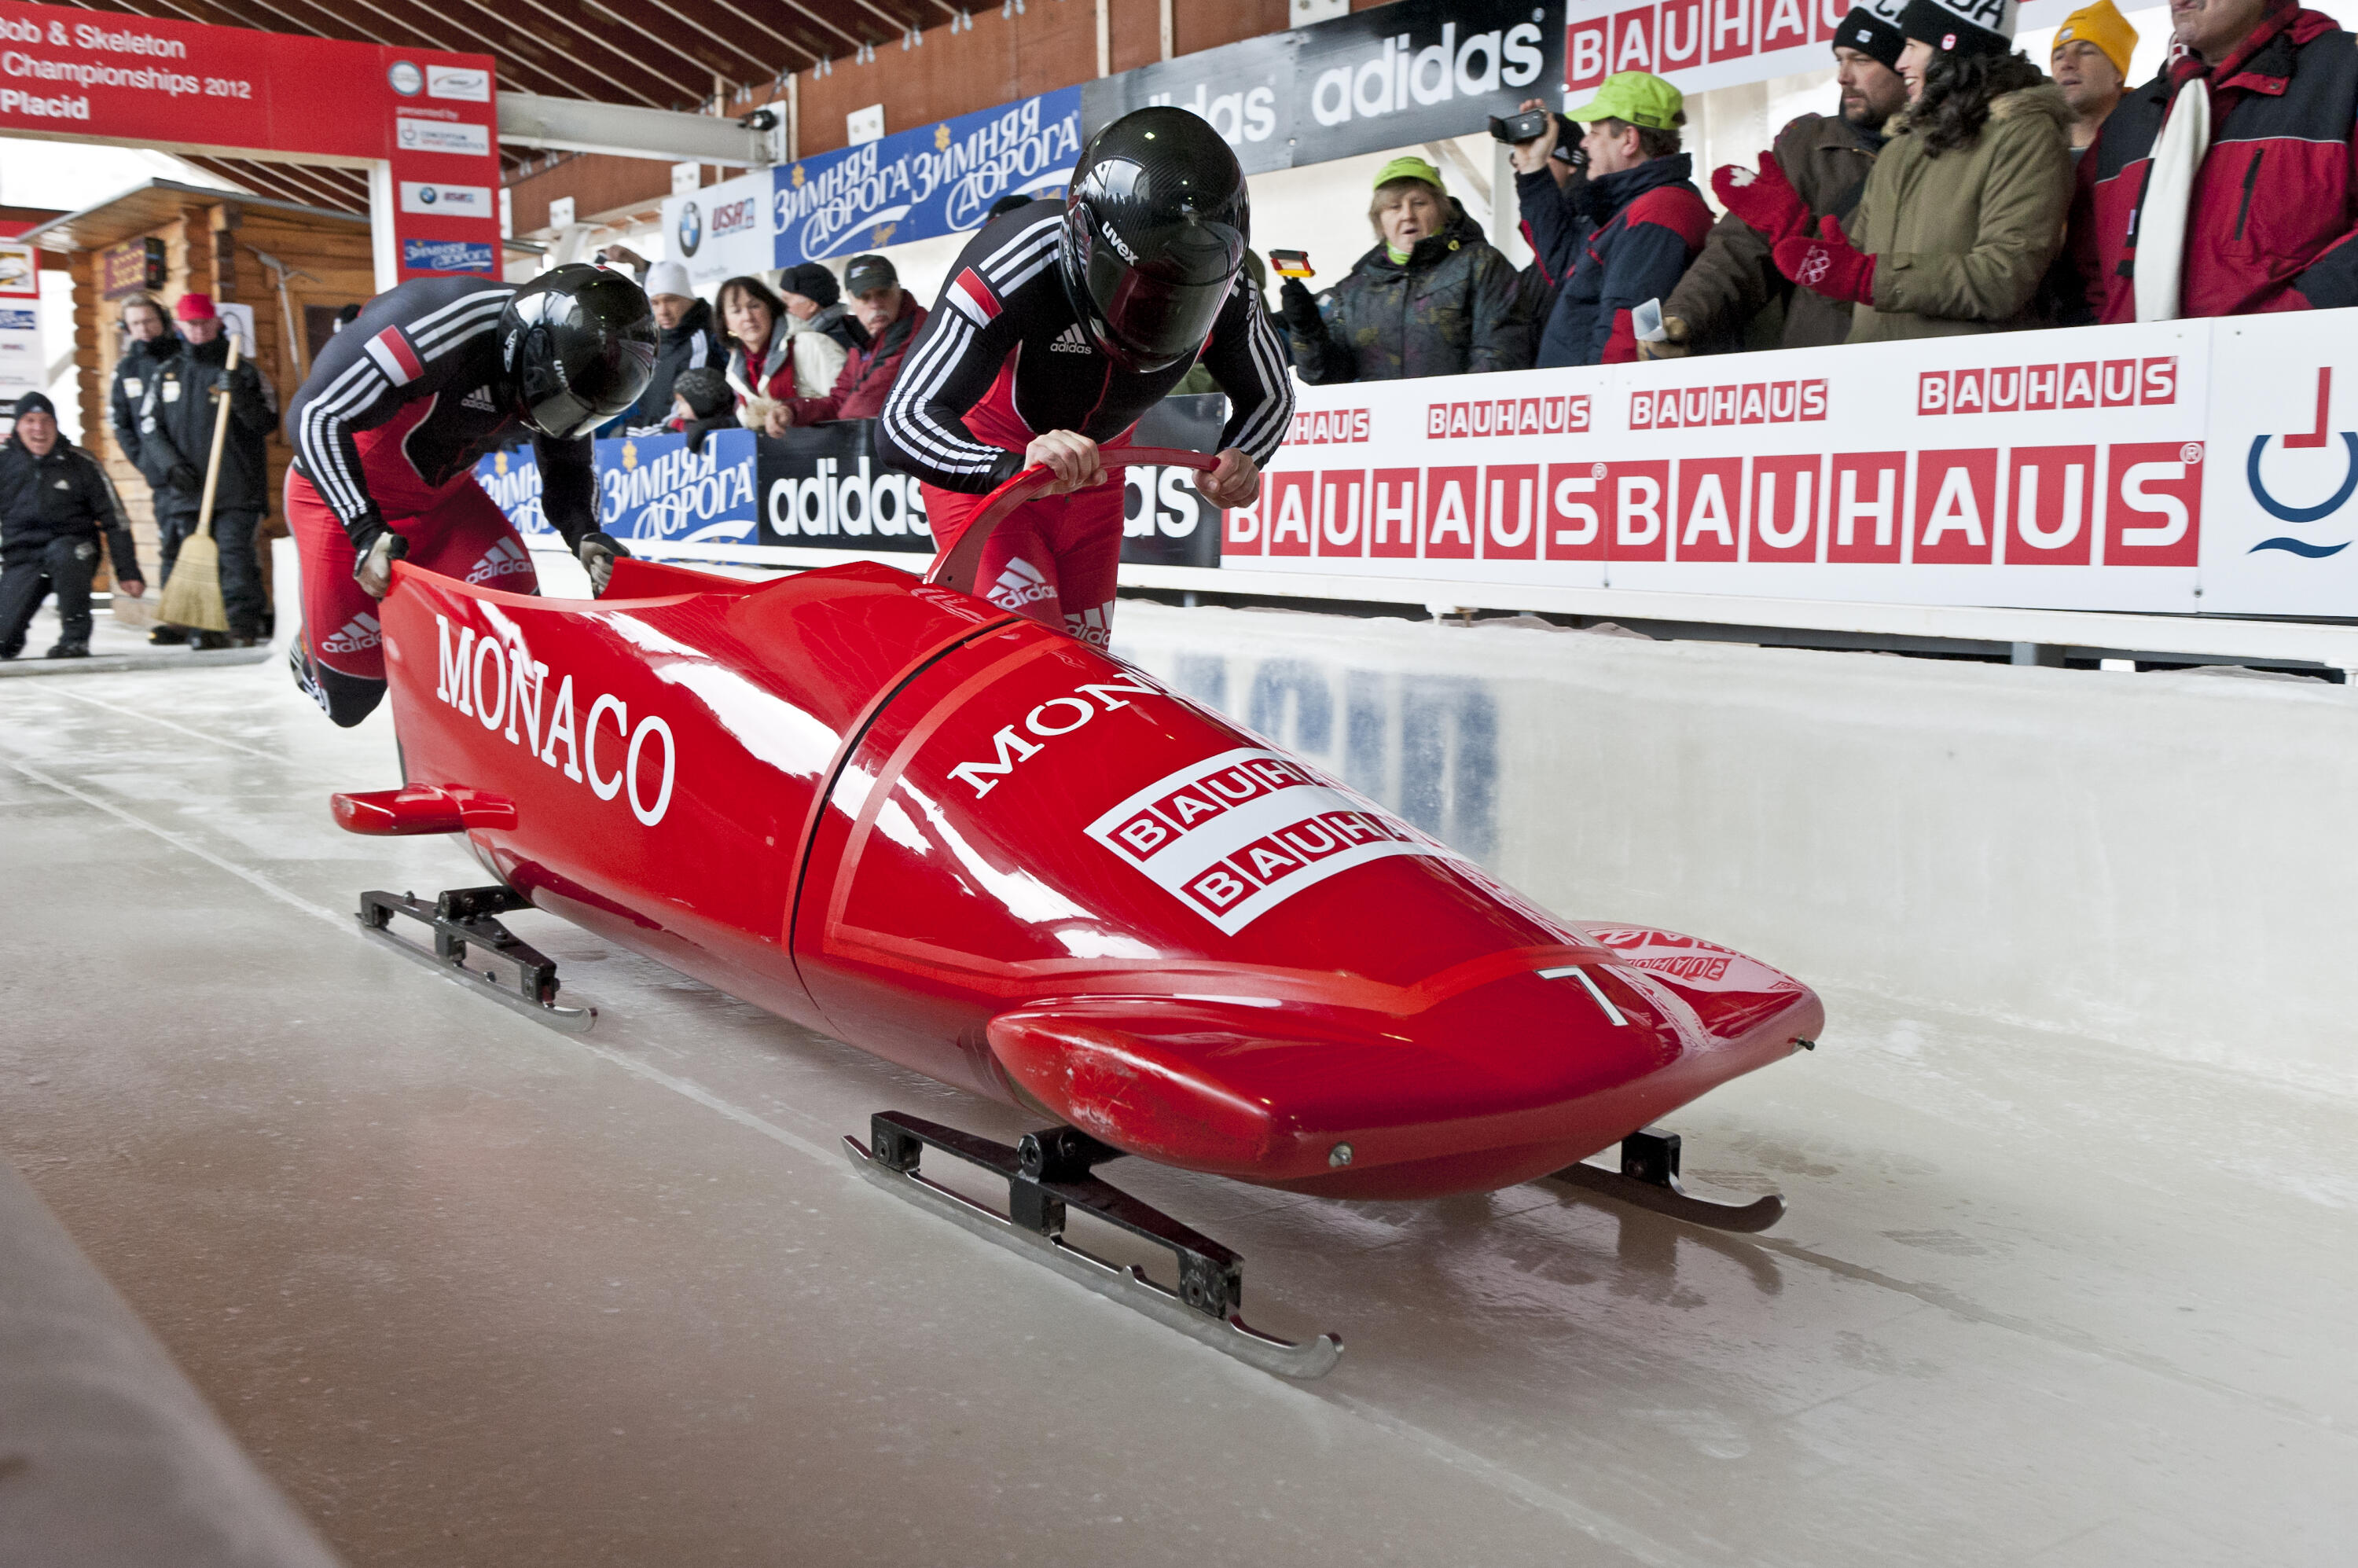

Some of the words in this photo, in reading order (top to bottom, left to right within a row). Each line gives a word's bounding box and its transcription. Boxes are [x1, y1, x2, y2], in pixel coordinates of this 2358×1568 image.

[47, 20, 70, 47] &
[75, 23, 186, 59] Skeleton
[2, 50, 200, 97] Championships
[204, 77, 252, 99] 2012
[1312, 22, 1543, 126] adidas
[0, 87, 90, 119] Placid
[912, 96, 1041, 204] ЗИМНЯЯ
[946, 116, 1079, 232] ДОРОГА
[773, 141, 877, 235] ЗИМНЯЯ
[800, 156, 911, 261] ДОРОГА
[1102, 221, 1139, 266] uvex
[1050, 340, 1092, 354] adidas
[1632, 384, 1826, 425] BAUHAUS
[1921, 362, 2175, 410] BAUHAUS
[1283, 413, 1368, 442] HAUS
[1429, 399, 1590, 434] BAUHAUS
[768, 456, 931, 537] adidas
[436, 614, 676, 827] MONACO
[1535, 965, 1628, 1026] 7
